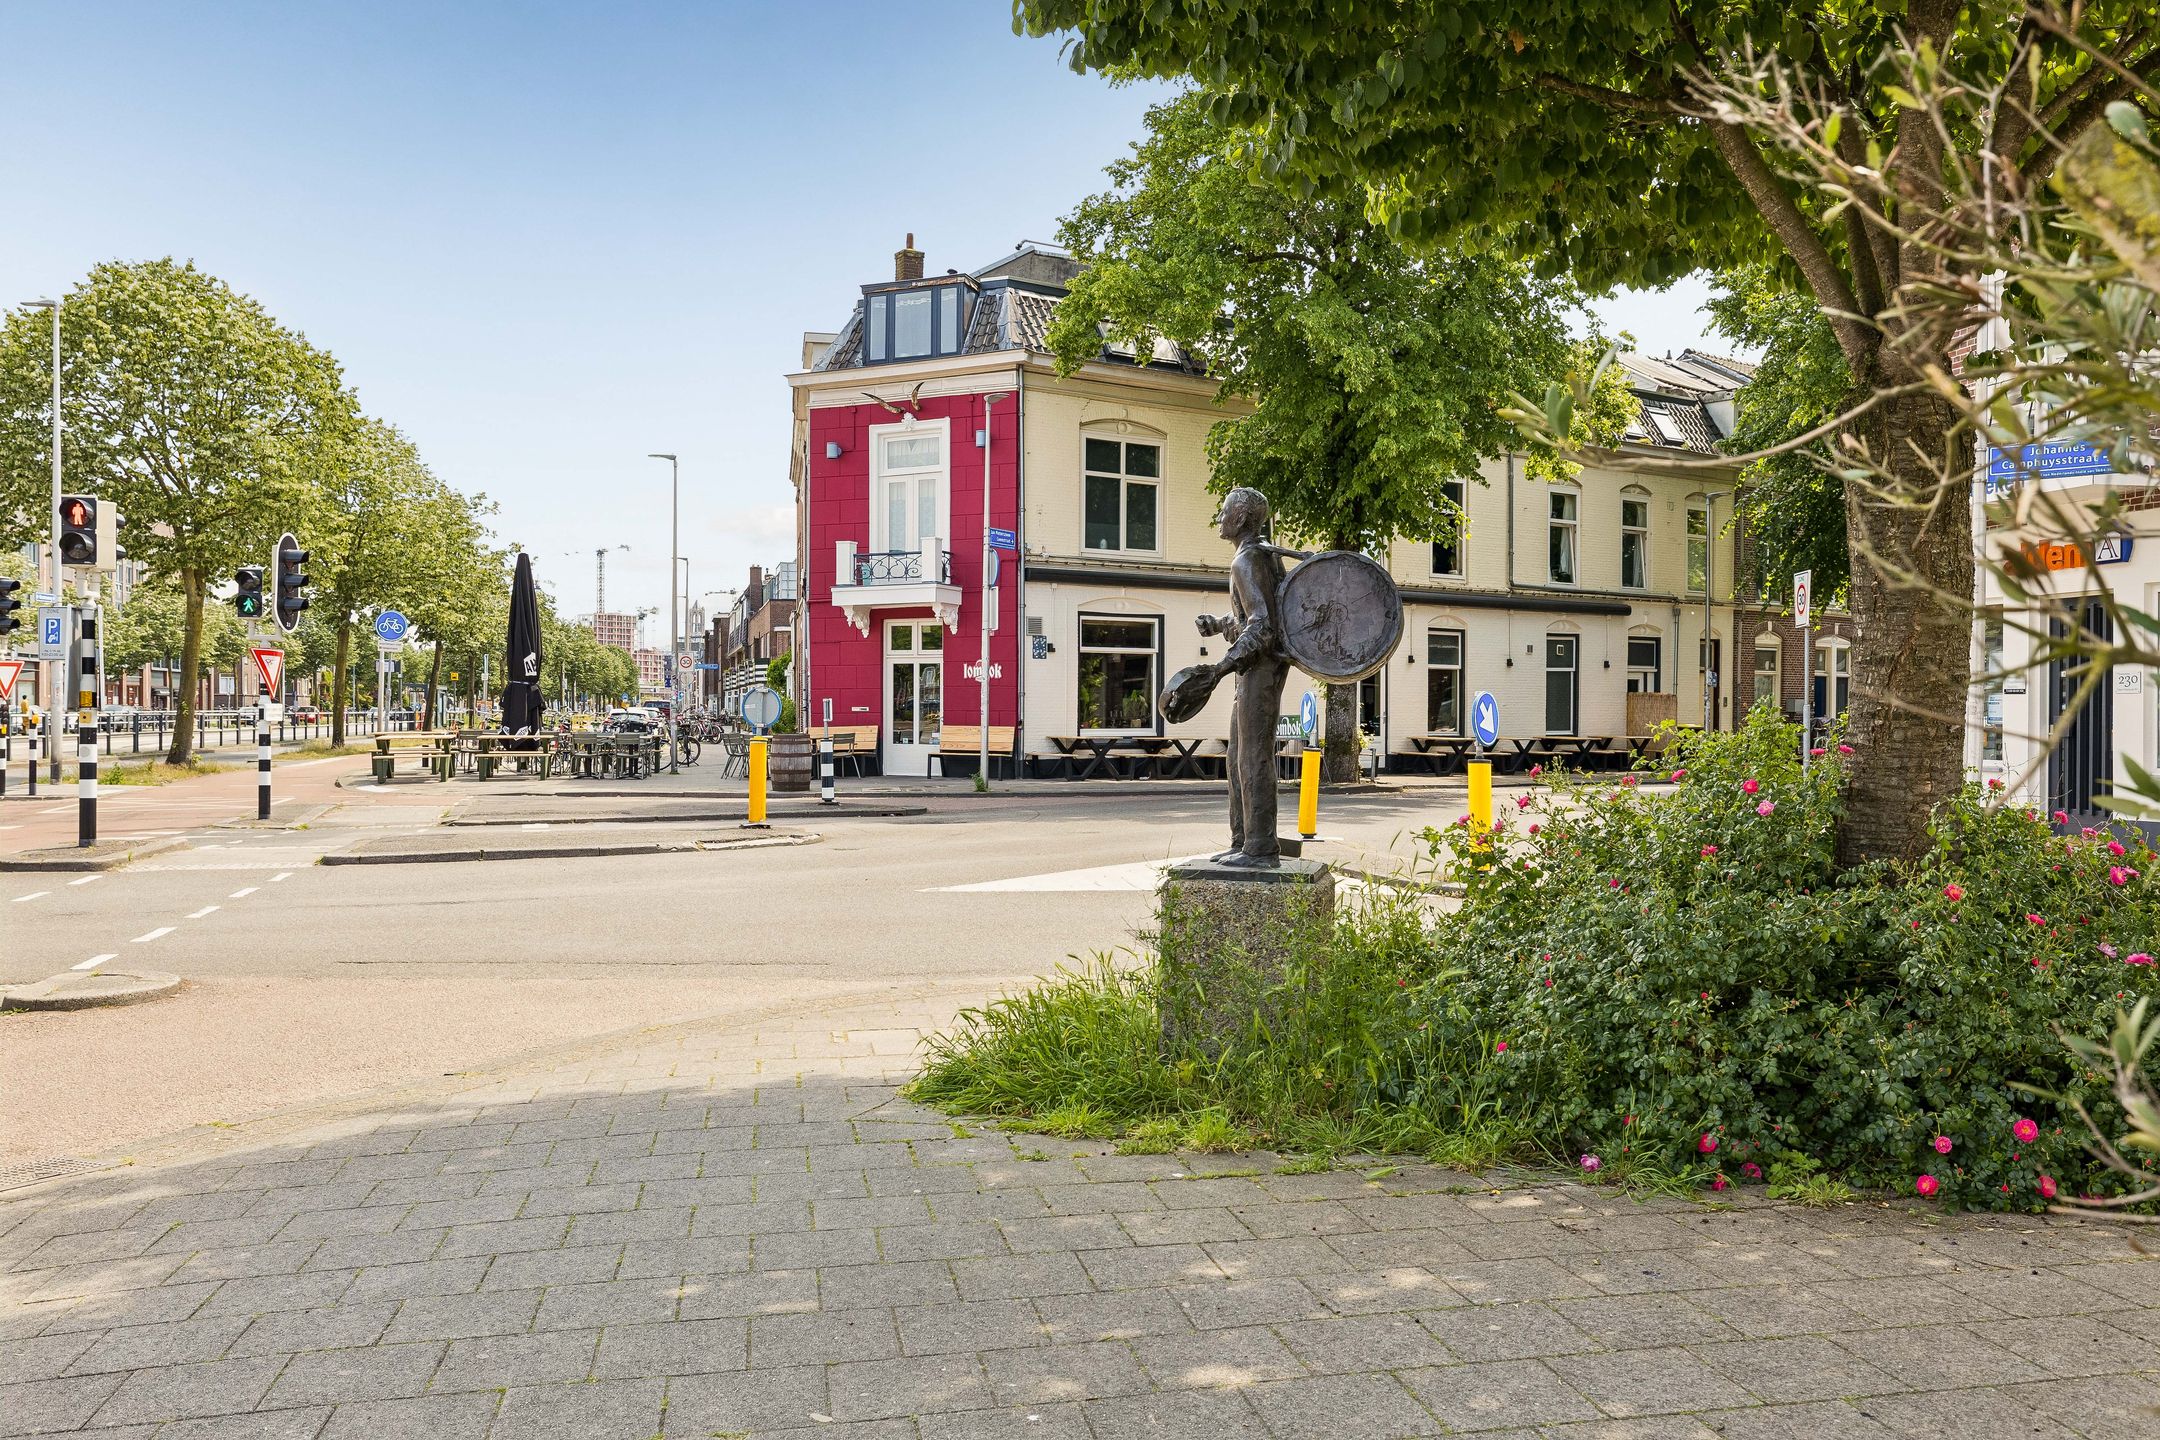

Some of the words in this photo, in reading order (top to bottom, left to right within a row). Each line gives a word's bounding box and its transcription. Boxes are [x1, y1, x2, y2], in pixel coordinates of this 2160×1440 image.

[2030, 443, 2086, 456] Johannes
[48, 619, 58, 634] P
[963, 660, 1002, 680] lomok
[2118, 675, 2139, 688] 230
